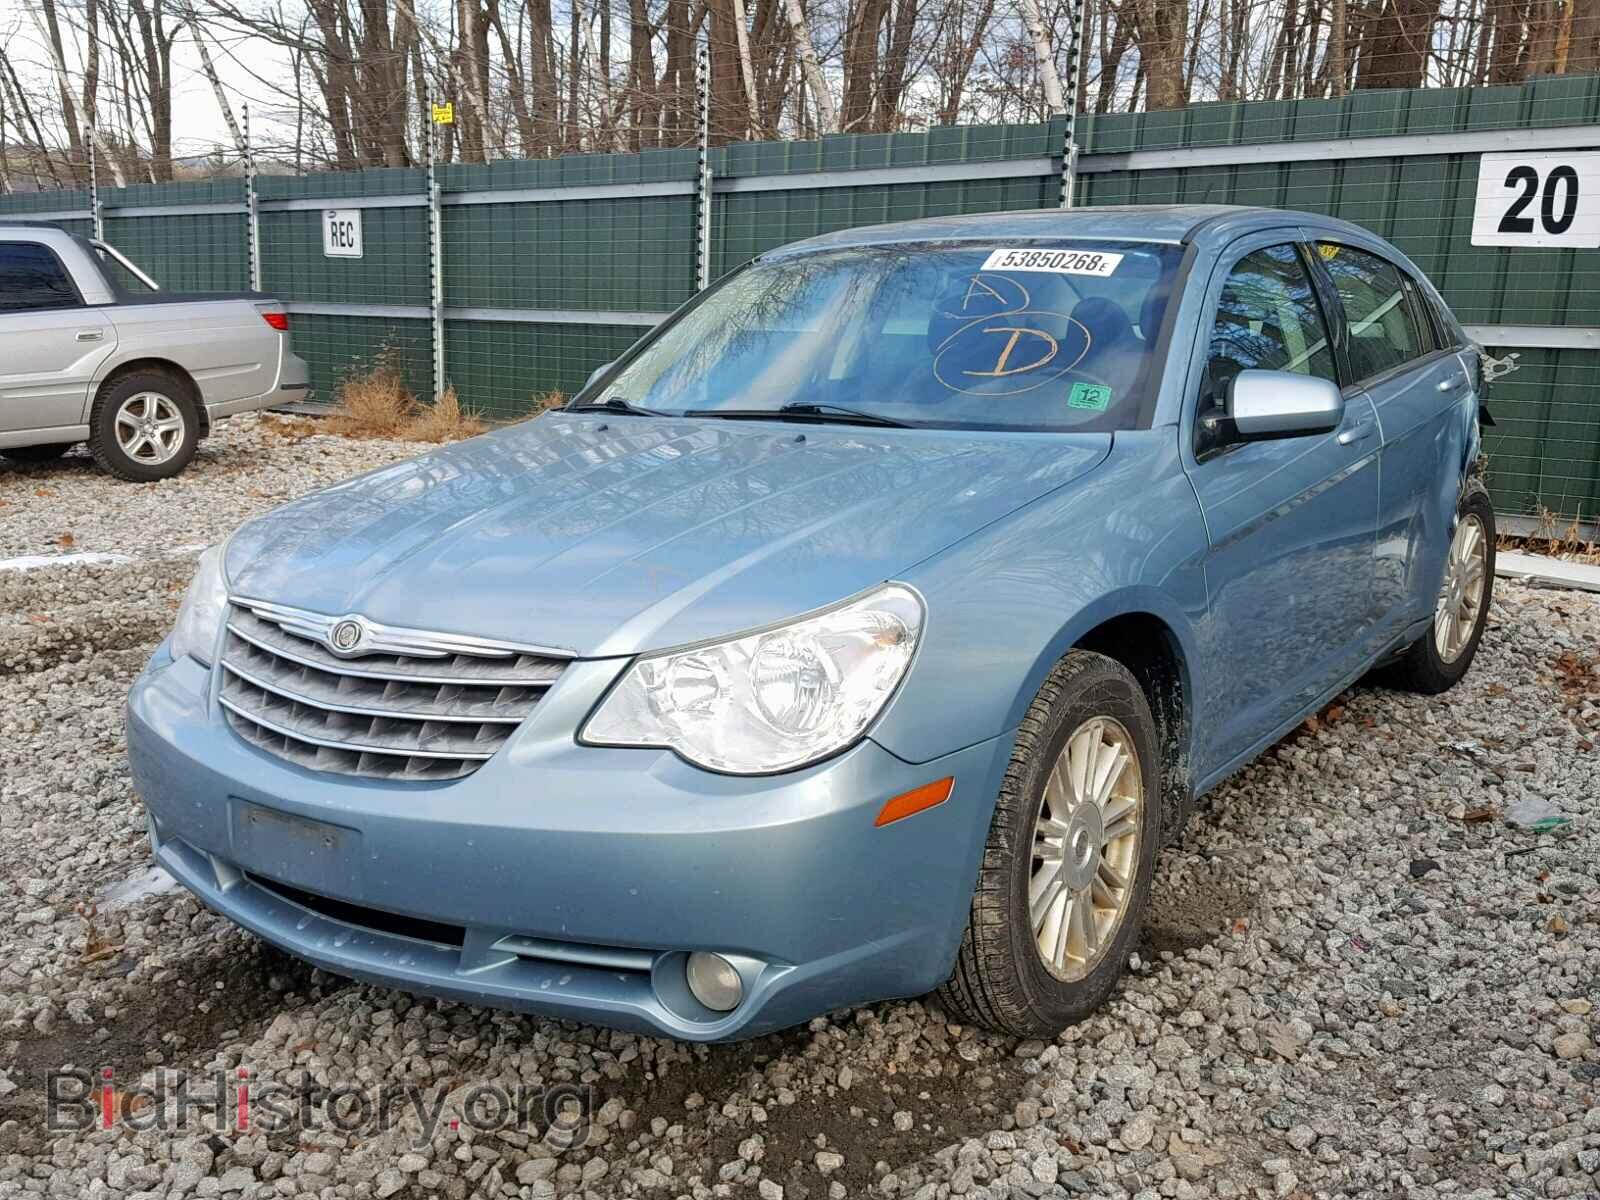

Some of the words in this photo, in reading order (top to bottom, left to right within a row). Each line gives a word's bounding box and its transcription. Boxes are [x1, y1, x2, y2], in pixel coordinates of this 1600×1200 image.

[1497, 165, 1579, 235] 20
[331, 221, 354, 248] REC
[1001, 251, 1103, 271] 53850268
